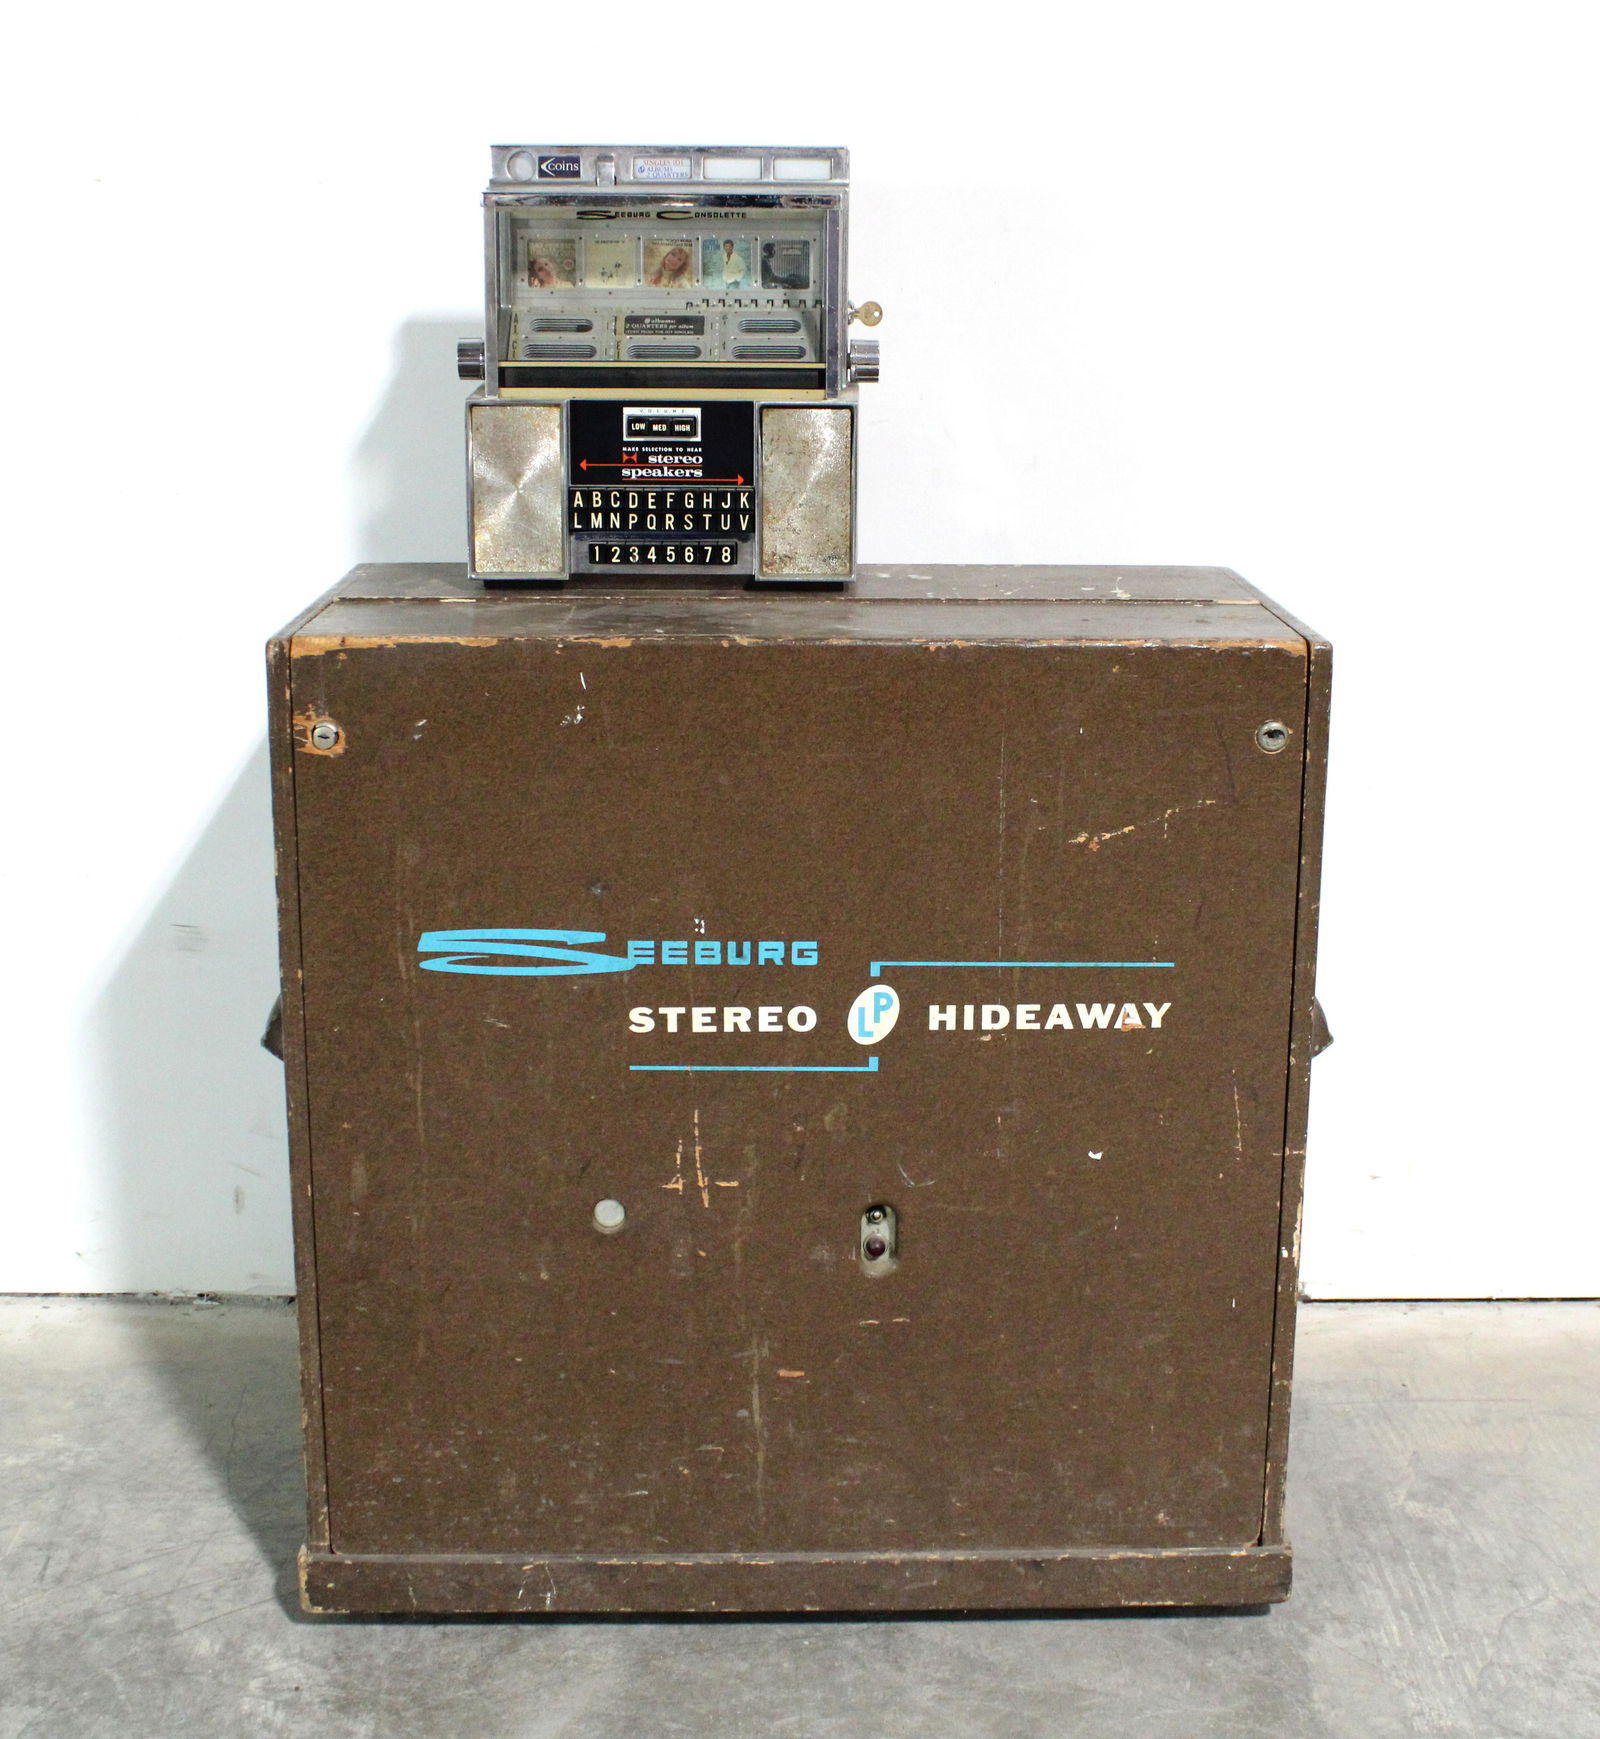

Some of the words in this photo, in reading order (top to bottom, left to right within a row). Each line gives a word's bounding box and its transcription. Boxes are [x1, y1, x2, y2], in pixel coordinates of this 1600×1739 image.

[548, 160, 579, 171] coins
[576, 210, 651, 220] SEEBURG
[656, 210, 748, 220] CONSOLETTE
[674, 424, 691, 432] HIGH
[648, 454, 703, 464] stereo
[621, 466, 703, 479] speakers
[574, 491, 583, 507] A
[593, 492, 601, 507] B
[611, 492, 620, 507] C
[629, 492, 638, 508] D
[648, 493, 656, 509] E
[667, 493, 675, 508] F
[685, 492, 693, 508] G
[703, 493, 712, 508] H
[722, 493, 730, 508] J
[741, 492, 749, 508] K
[574, 513, 582, 528] L
[591, 513, 602, 528] M
[610, 513, 620, 528] N
[629, 514, 638, 530] P
[647, 514, 656, 530] Q
[666, 514, 674, 530] R
[684, 514, 693, 530] S
[703, 514, 712, 530] T
[721, 515, 730, 530] U
[740, 515, 749, 530] V
[595, 547, 599, 562] 1
[612, 547, 620, 562] 2
[630, 547, 638, 562] 3
[648, 547, 656, 562] 4
[667, 547, 675, 562] 5
[685, 547, 693, 562] 6
[704, 547, 712, 562] 7
[722, 547, 730, 562] 8
[417, 928, 818, 976] SEEBURG
[628, 1005, 818, 1034] STEREO
[858, 991, 894, 1037] LP
[928, 1002, 1172, 1031] HIDEAWAY
